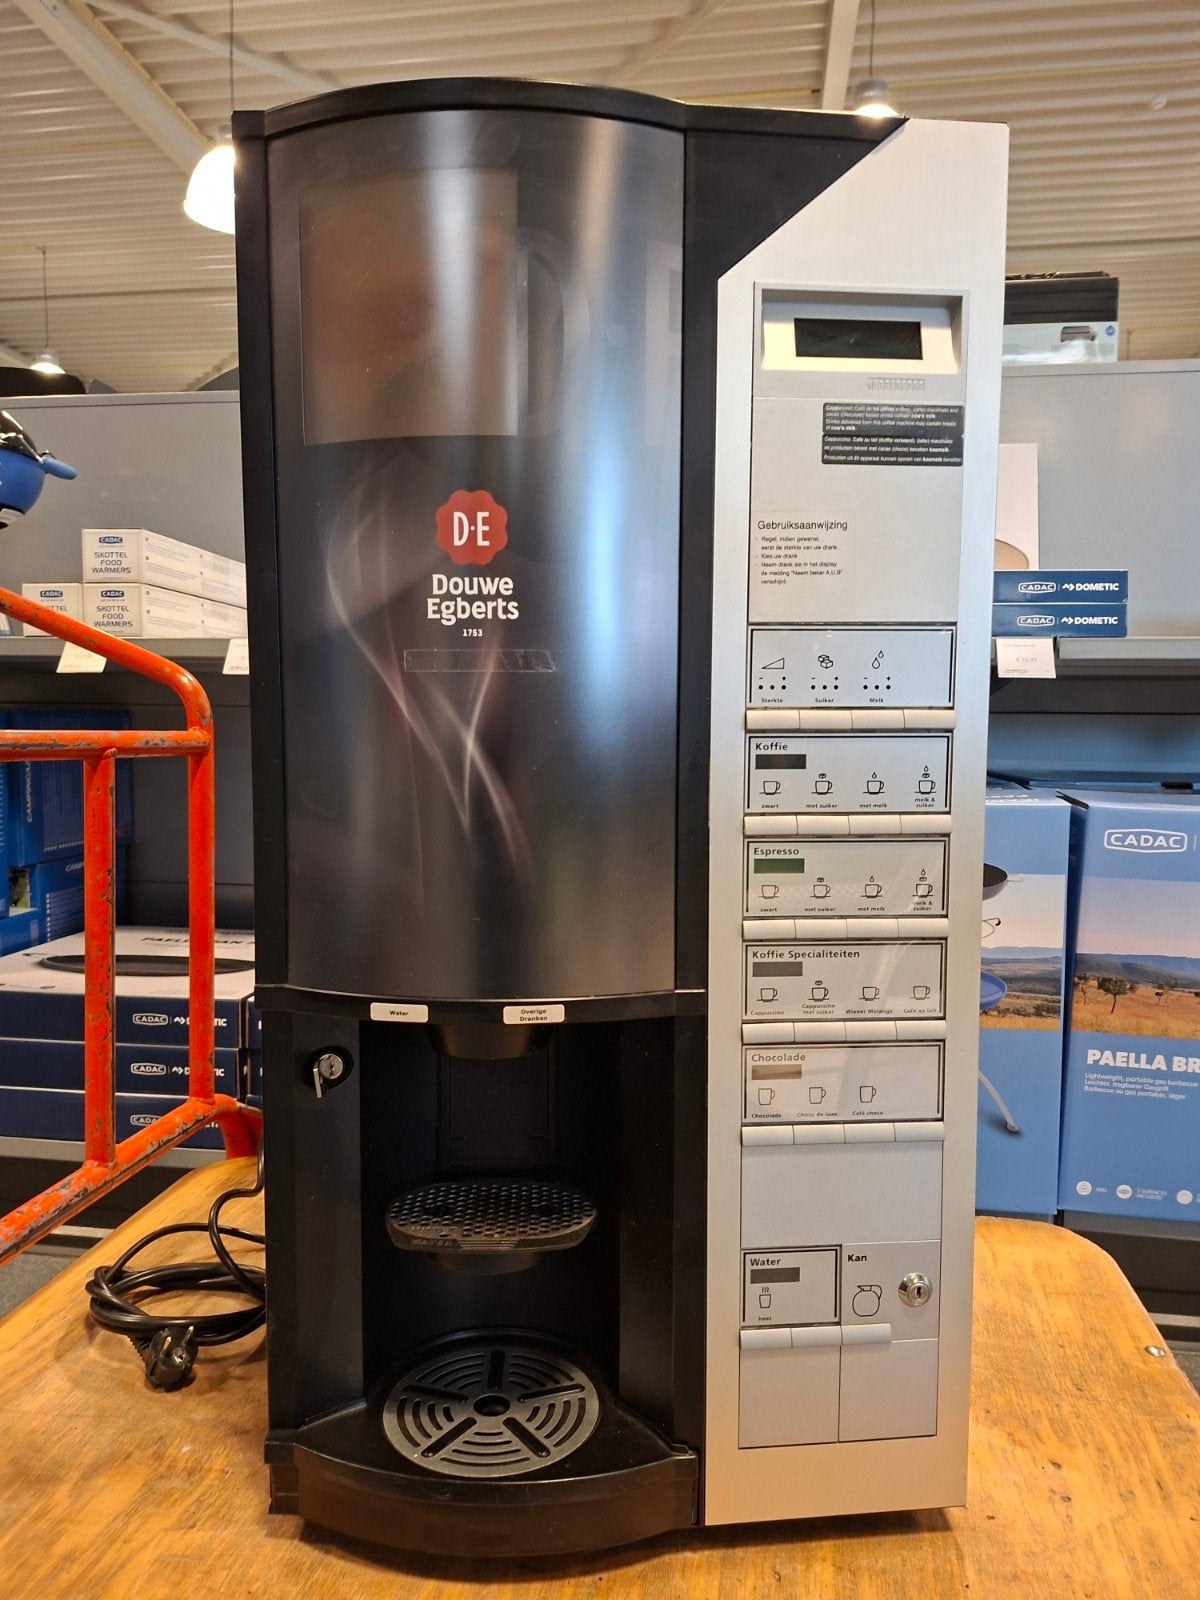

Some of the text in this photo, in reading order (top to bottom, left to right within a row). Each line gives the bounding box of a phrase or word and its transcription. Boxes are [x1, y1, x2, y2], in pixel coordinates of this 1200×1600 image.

[757, 520, 848, 531] Gebruiksaanwijzing
[432, 574, 513, 595] Douwe
[1075, 583, 1120, 591] DOMETIC
[427, 597, 519, 625] Egberts
[1074, 616, 1118, 624] DOMETIC
[462, 629, 483, 637] 1753
[756, 742, 788, 750] Koffie
[1110, 834, 1181, 848] CADAC
[754, 848, 800, 857] Espresso
[753, 950, 860, 960] Koffie Specialiteiten
[752, 1054, 806, 1062] Chocolade
[1087, 1049, 1167, 1071] PAELLA
[1085, 1073, 1124, 1081] Lightweight,
[750, 1258, 781, 1267] Water
[848, 1254, 867, 1262] Kan
